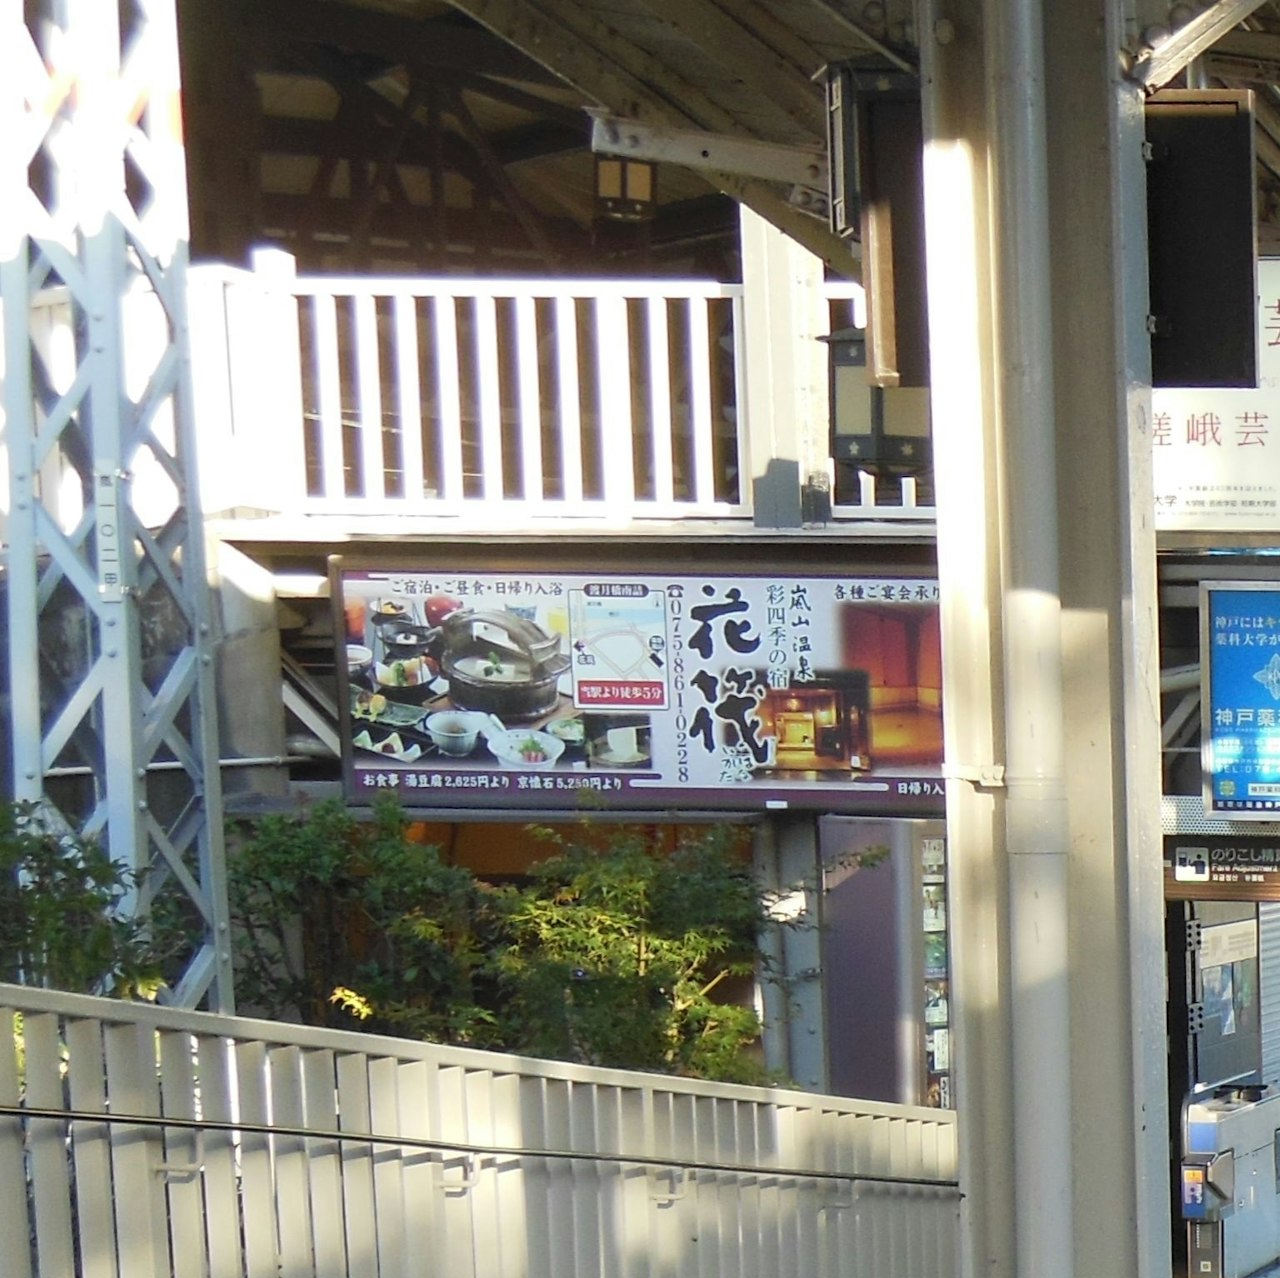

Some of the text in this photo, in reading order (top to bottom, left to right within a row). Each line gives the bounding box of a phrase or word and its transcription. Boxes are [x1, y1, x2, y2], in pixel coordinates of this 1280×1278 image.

[391, 580, 564, 597] ご宿泊・ご昼食・日帰り入浴
[766, 584, 787, 688] 彩四季の宿
[790, 584, 812, 681] 嵐山温泉
